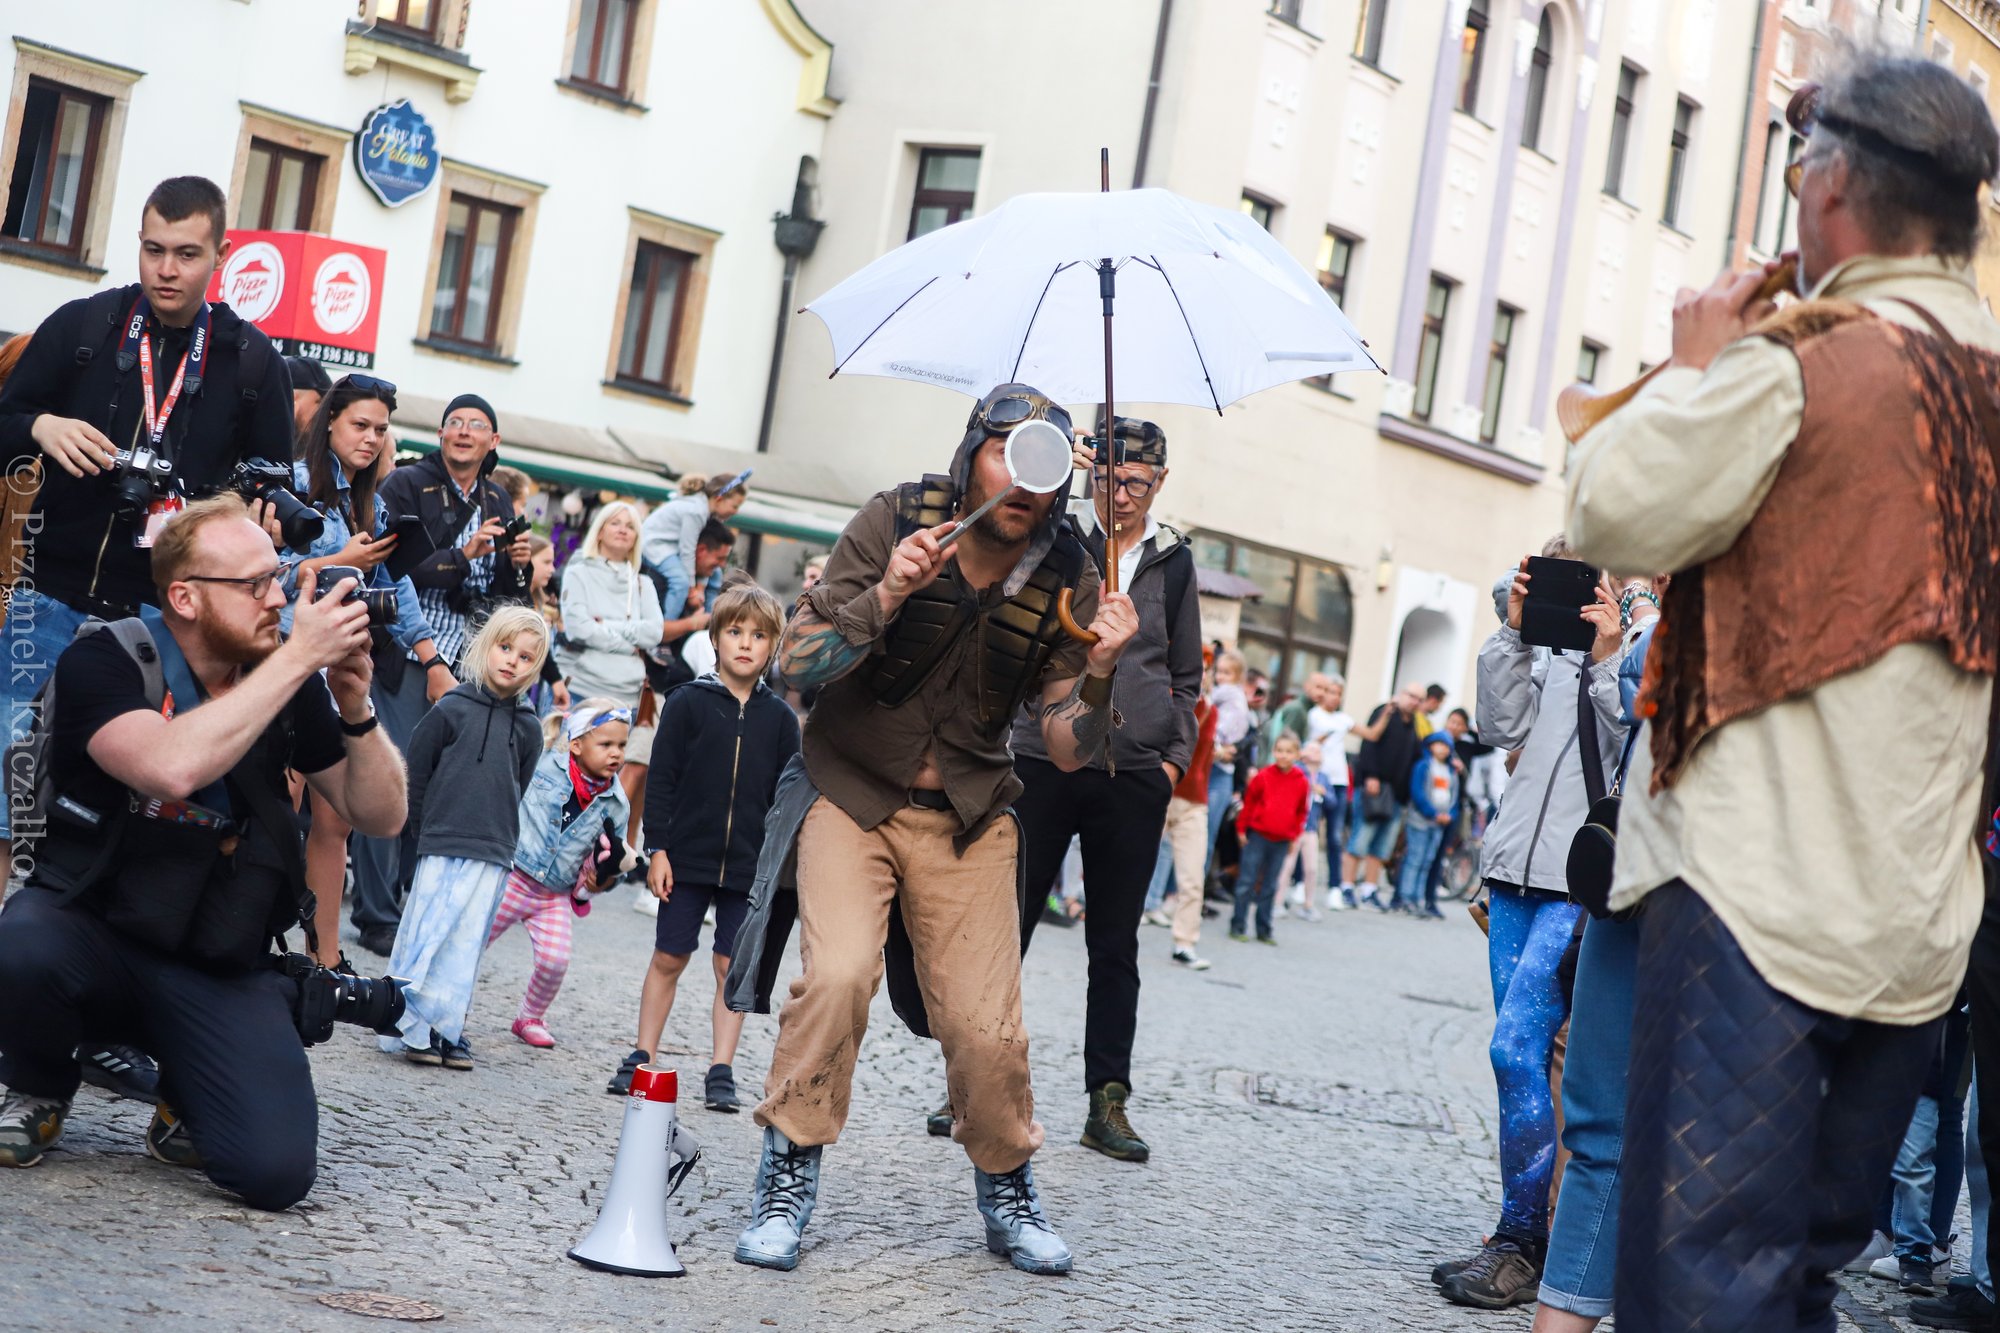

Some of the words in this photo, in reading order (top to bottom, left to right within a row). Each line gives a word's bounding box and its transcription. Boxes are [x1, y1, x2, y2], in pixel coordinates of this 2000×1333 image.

[368, 133, 430, 170] Polonia
[232, 274, 268, 295] Pizza
[323, 284, 356, 304] Pizza
[237, 290, 263, 308] Hut
[327, 302, 351, 317] Hut
[128, 314, 144, 339] EOS
[191, 327, 206, 362] Canon
